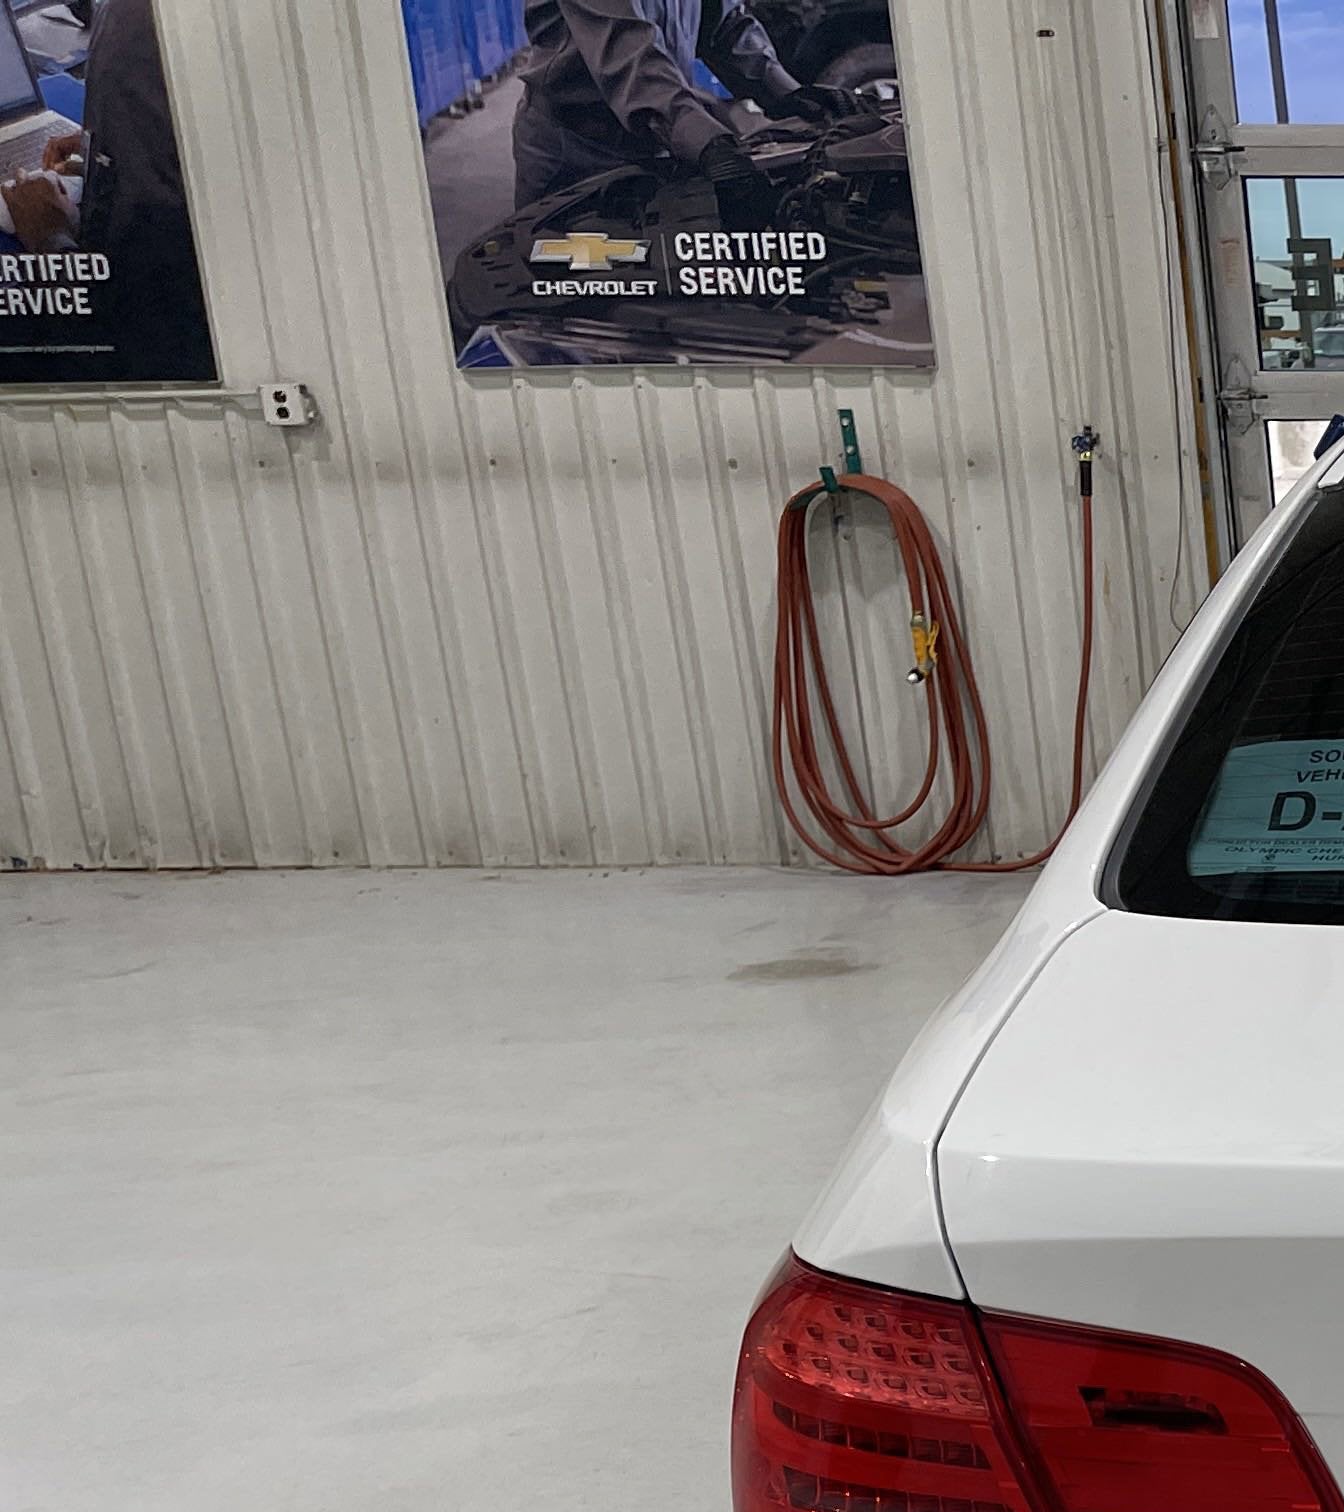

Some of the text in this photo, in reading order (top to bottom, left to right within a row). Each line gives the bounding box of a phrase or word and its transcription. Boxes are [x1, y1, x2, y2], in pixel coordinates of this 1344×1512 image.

[673, 231, 827, 261] CERTIFIED
[0, 253, 111, 282] RTIFIED
[678, 266, 807, 296] SERVICE
[531, 280, 658, 296] CHEVROLET
[1224, 846, 1301, 855] OLYMPIC
